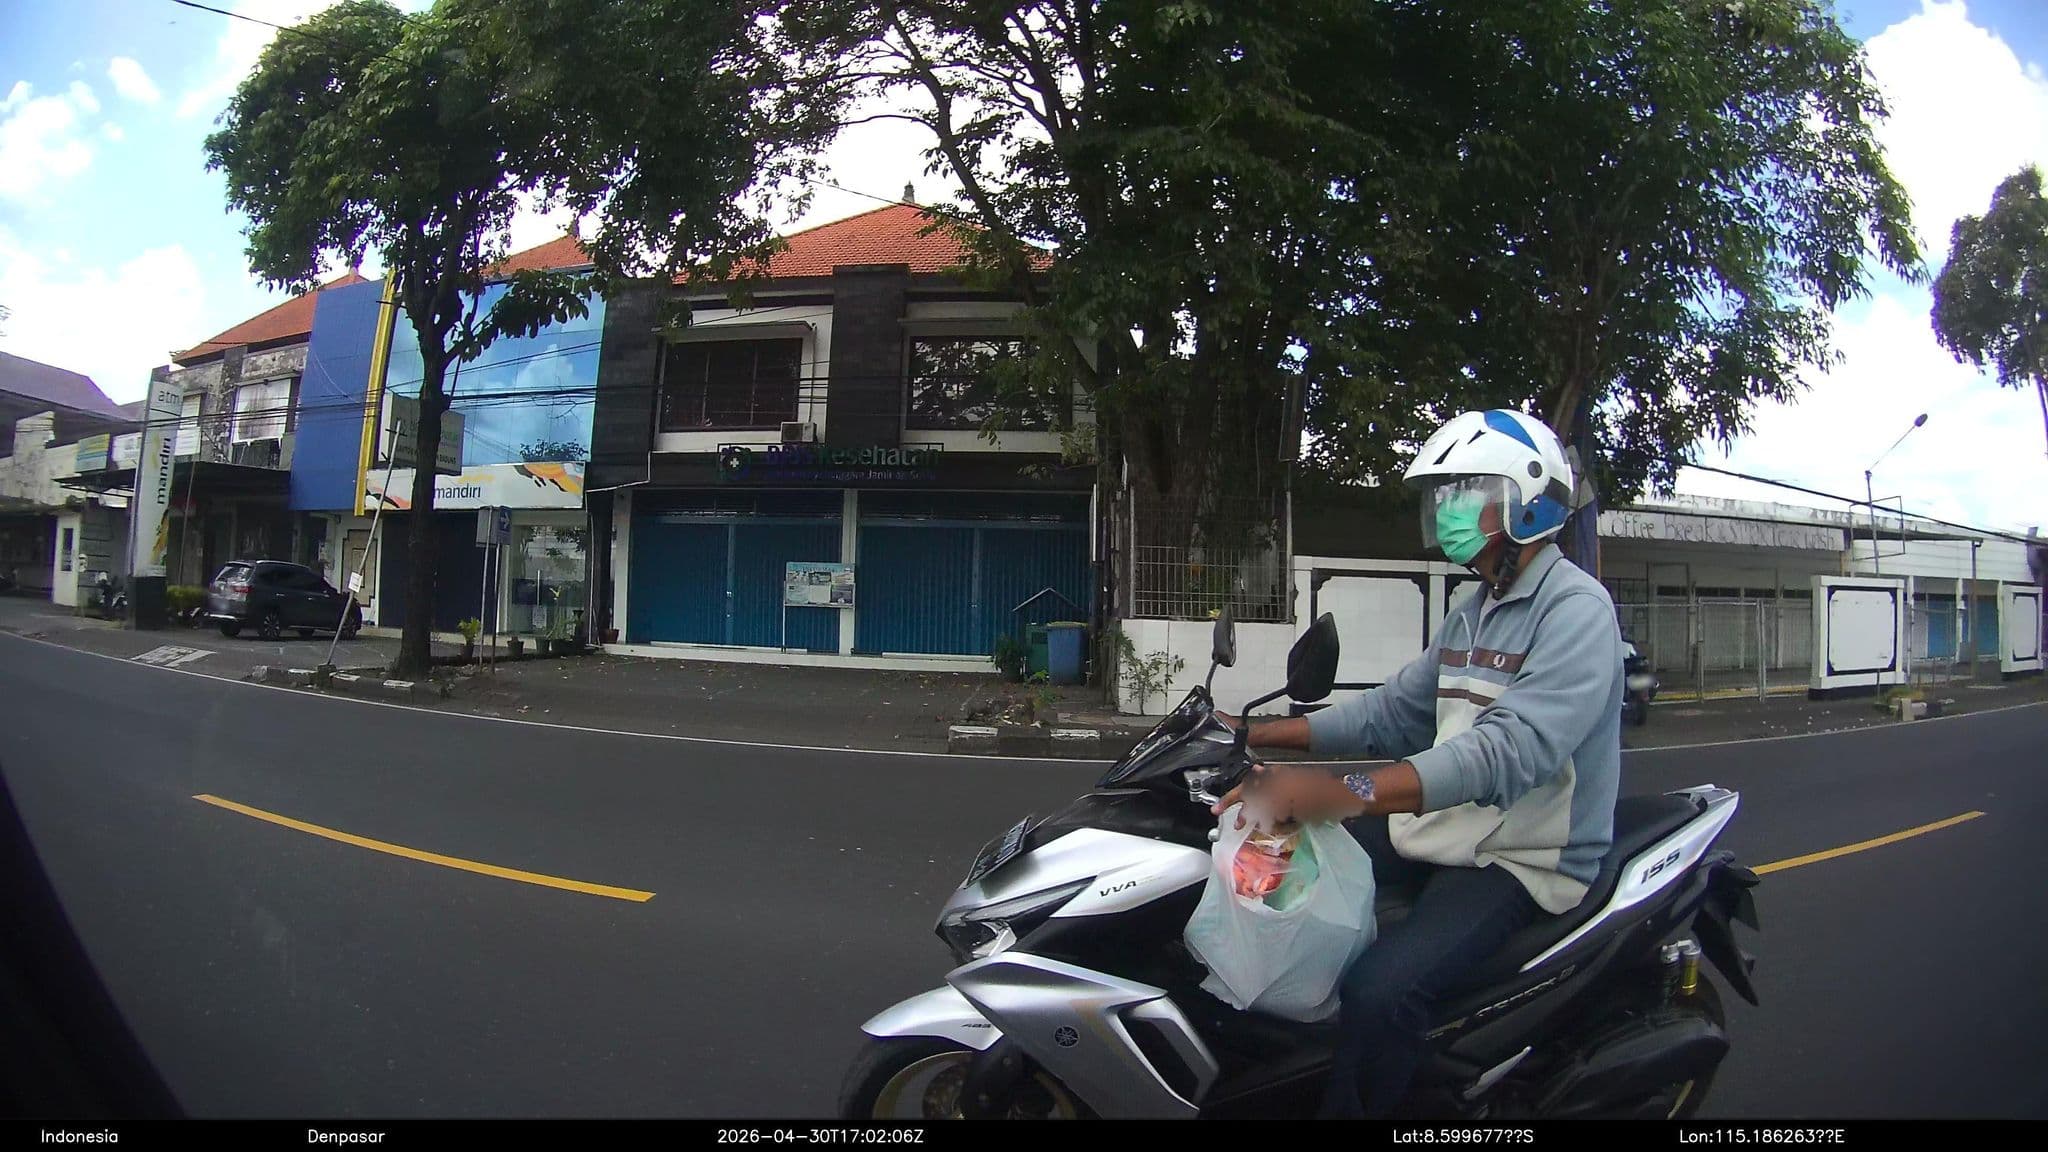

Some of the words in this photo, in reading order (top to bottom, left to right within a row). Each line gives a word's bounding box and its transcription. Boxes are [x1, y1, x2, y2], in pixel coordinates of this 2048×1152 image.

[158, 389, 179, 404] atm
[157, 437, 171, 505] mandiri
[434, 482, 481, 499] mandiri
[1641, 848, 1680, 884] 155
[1099, 880, 1138, 897] VVA
